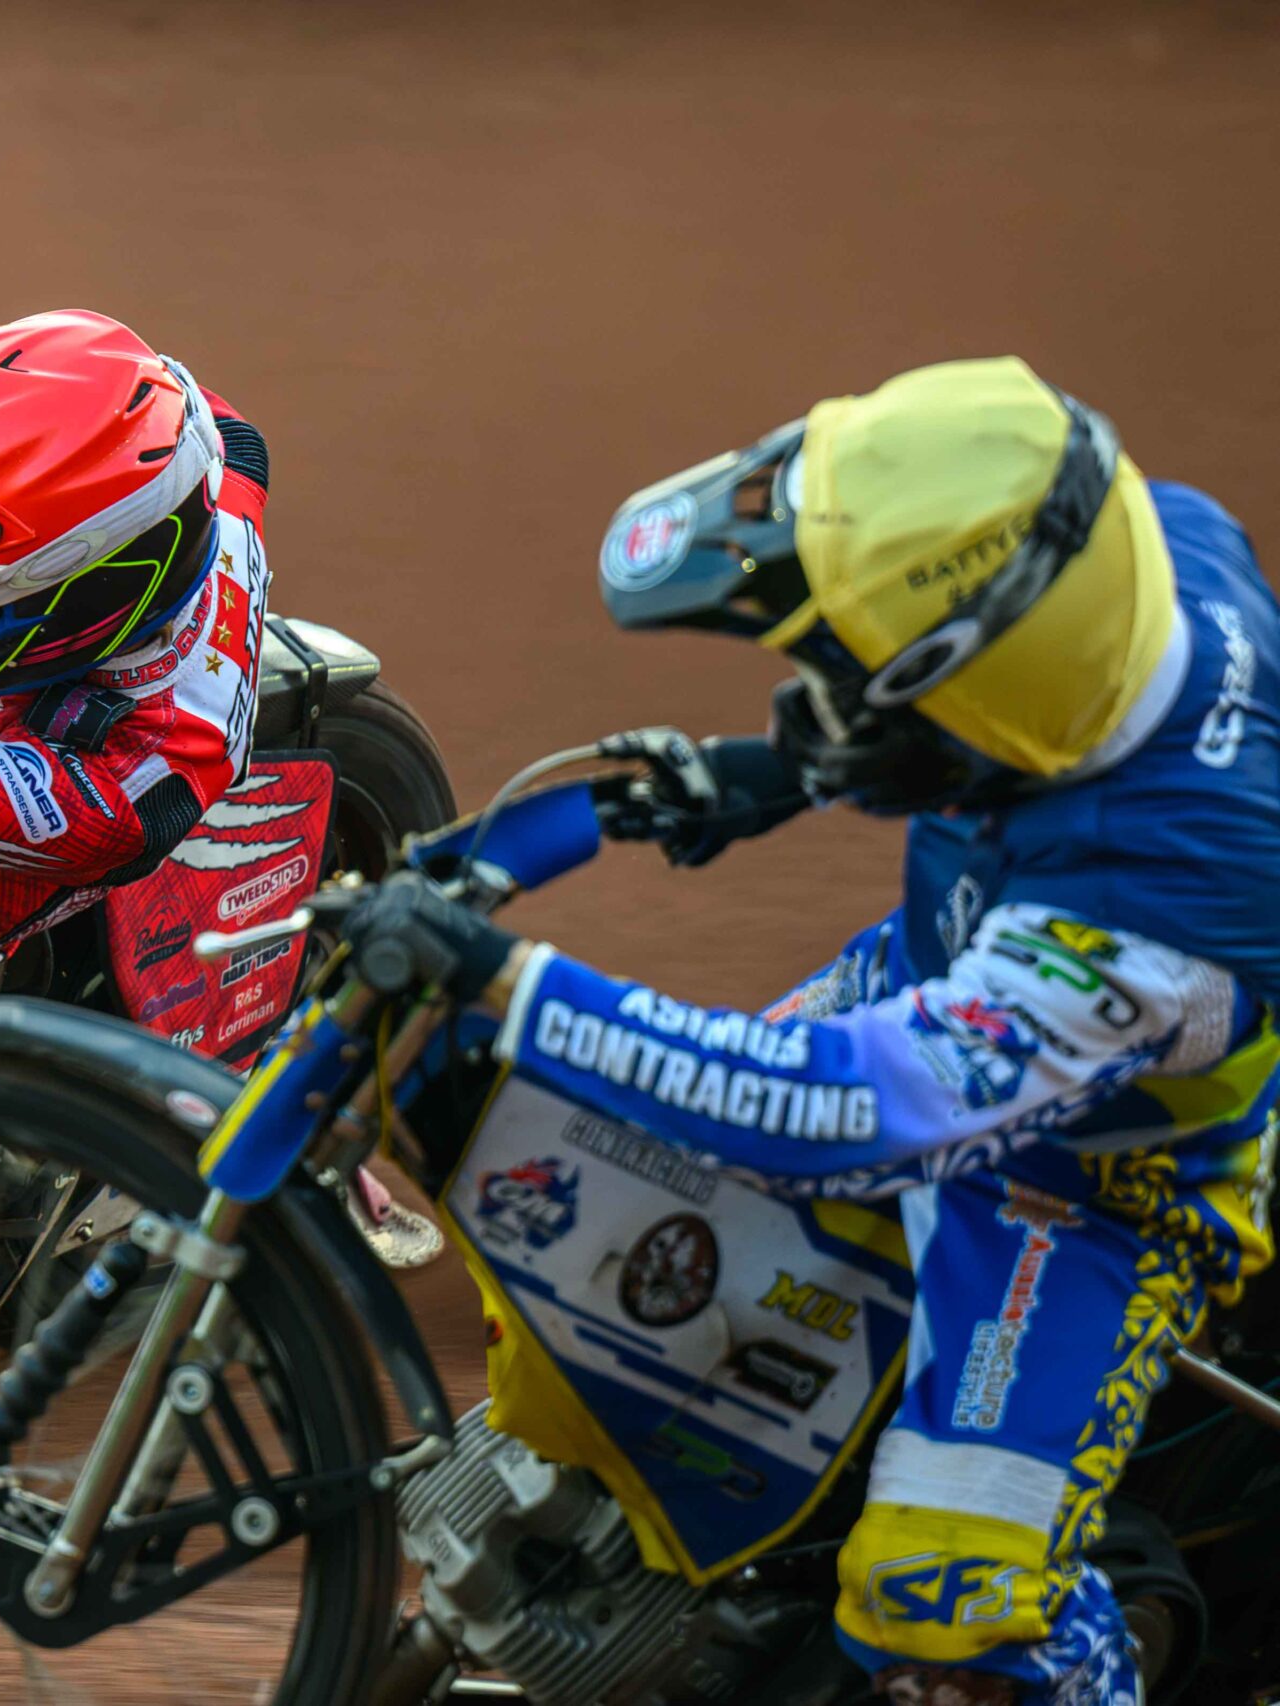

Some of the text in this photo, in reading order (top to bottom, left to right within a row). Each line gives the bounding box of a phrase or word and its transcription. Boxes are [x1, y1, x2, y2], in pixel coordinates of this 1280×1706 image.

[71, 762, 117, 821] Racewear
[226, 861, 300, 912] TWEEDSIDE
[234, 982, 263, 1012] R&S
[170, 1024, 206, 1050] ffys
[218, 1000, 275, 1042] Lorriman
[534, 998, 878, 1143] CONTRACTING
